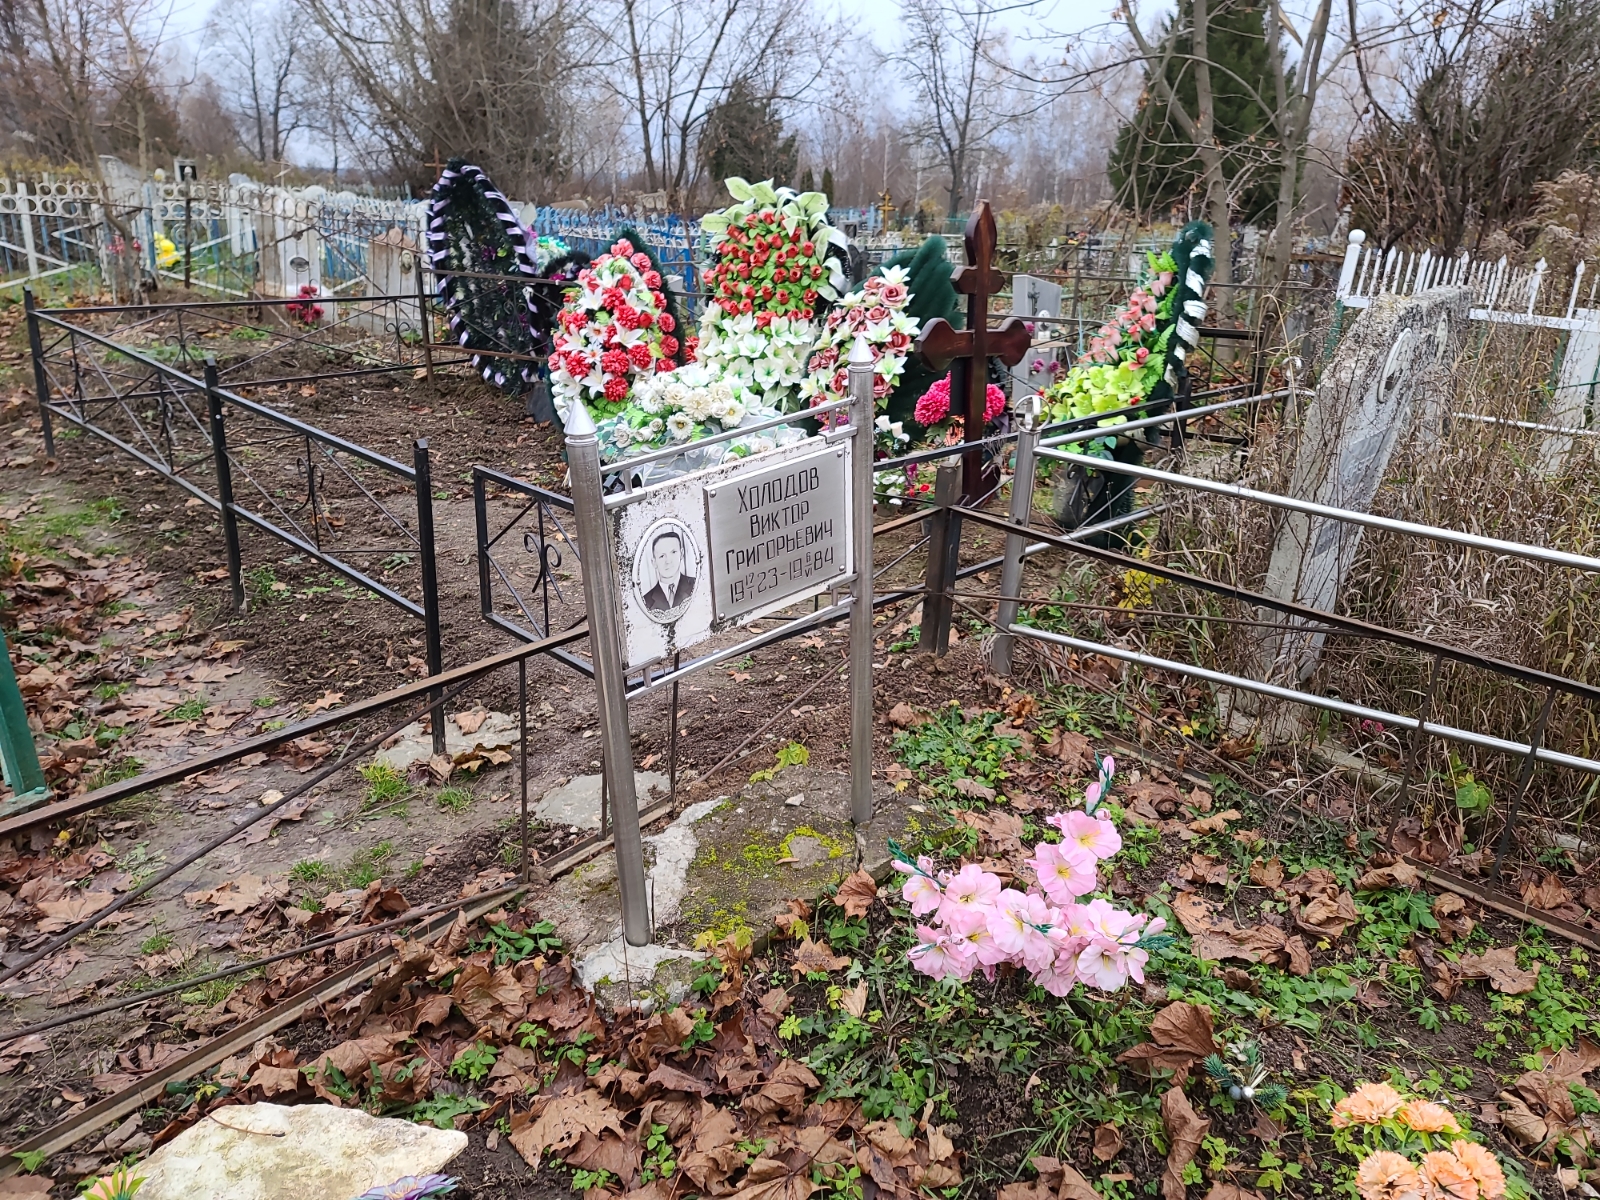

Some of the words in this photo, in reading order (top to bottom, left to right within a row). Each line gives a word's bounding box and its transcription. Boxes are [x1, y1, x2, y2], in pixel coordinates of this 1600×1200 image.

[737, 467, 819, 514] ХОЛОДОВ
[750, 500, 809, 539] ВИКТОР
[726, 518, 833, 575] ГРИГОРЬЕВИЧ
